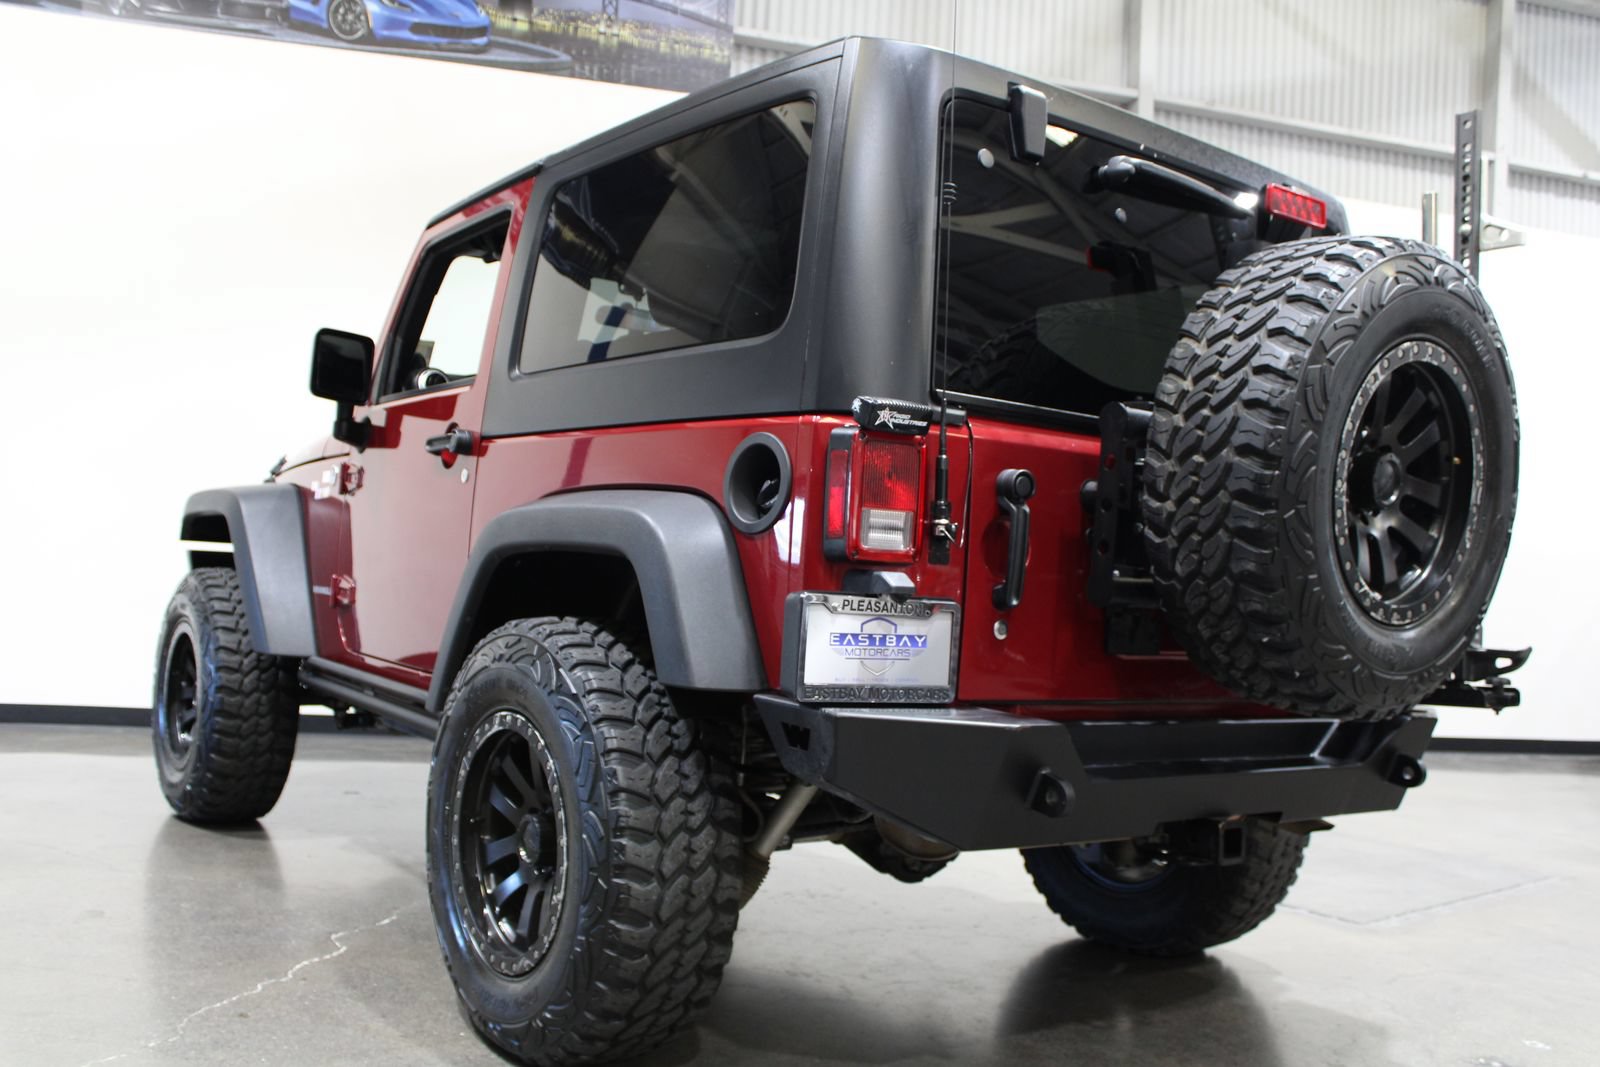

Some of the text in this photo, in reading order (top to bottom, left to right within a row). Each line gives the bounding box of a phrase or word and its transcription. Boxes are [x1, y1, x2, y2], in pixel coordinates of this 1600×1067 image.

[830, 633, 927, 648] EASTBAY
[844, 648, 911, 658] MOTORCARS
[803, 686, 950, 701] EASTBAY MOTORCARS
